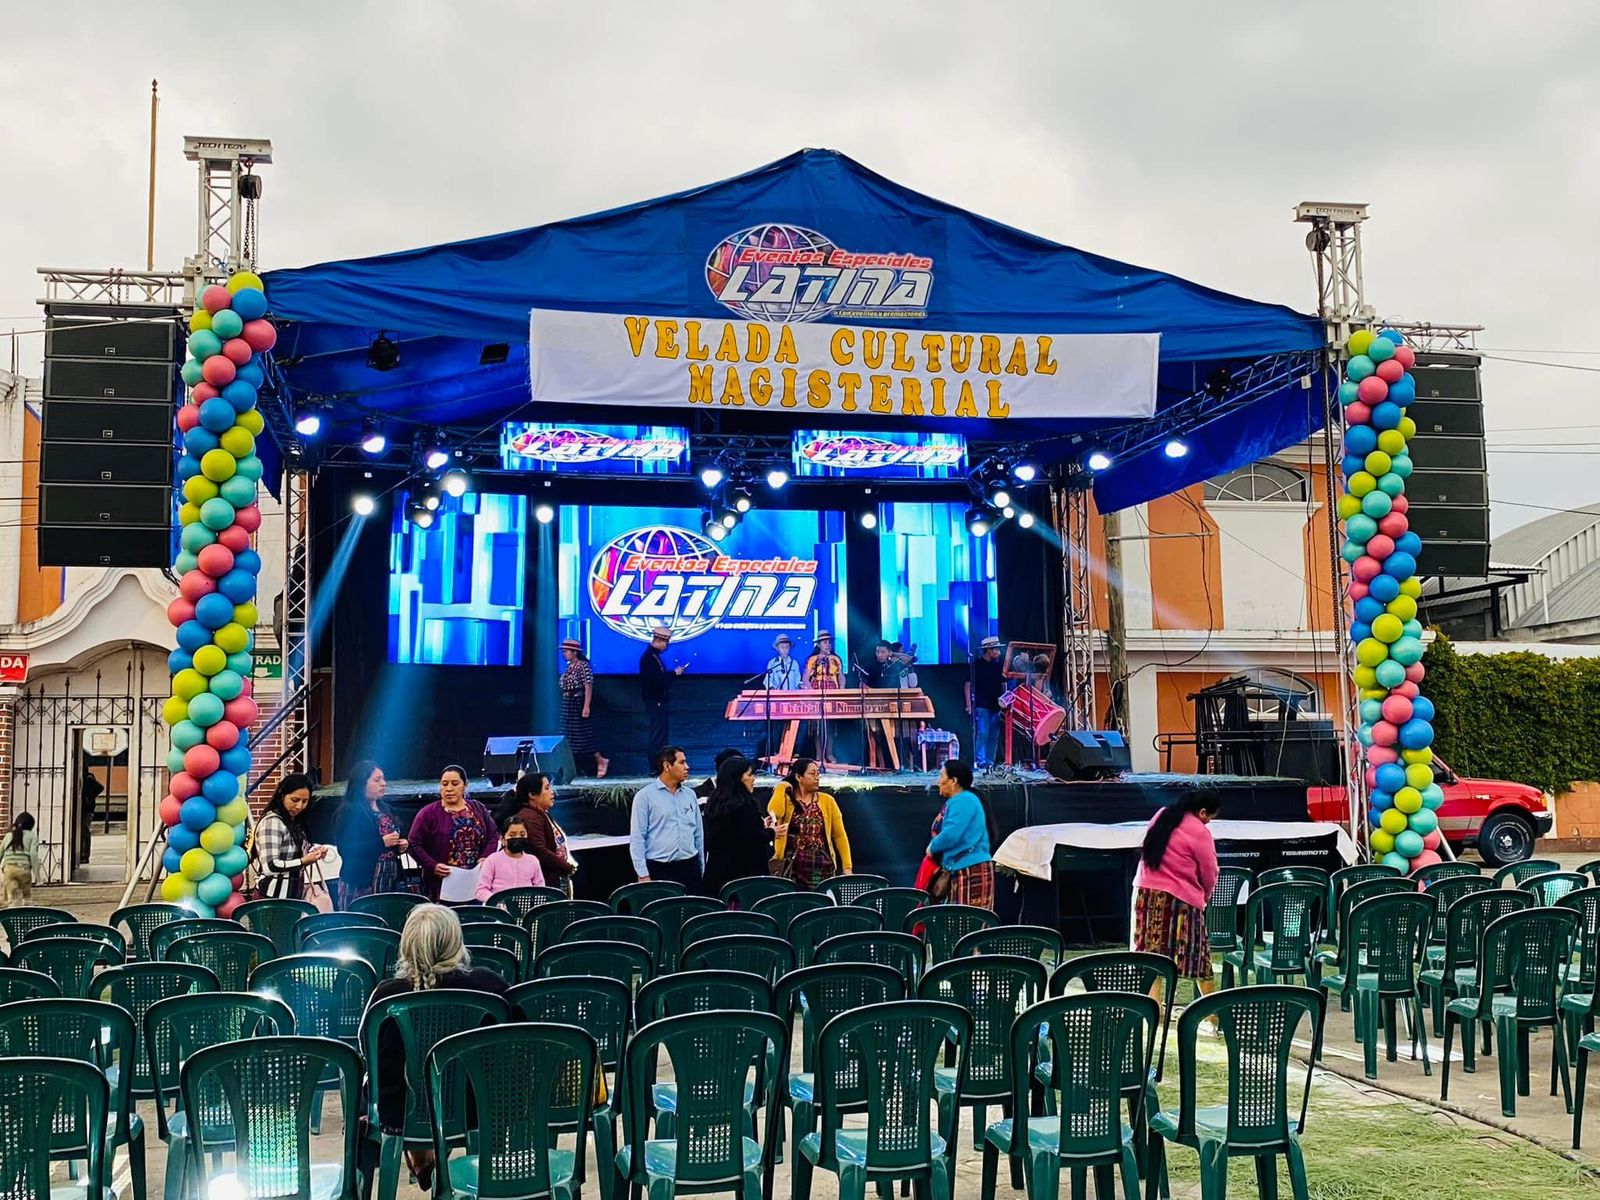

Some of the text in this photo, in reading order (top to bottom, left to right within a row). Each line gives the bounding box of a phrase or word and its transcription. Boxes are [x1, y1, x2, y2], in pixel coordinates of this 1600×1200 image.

[739, 249, 931, 269] Eventos Especiales
[718, 265, 931, 306] LATINA
[624, 316, 1058, 376] VELADA CULTURAL
[688, 363, 1010, 418] MAGISTERIAL
[625, 555, 817, 574] Eventos Especiales
[601, 574, 816, 617] LATINA
[256, 655, 282, 665] RAD
